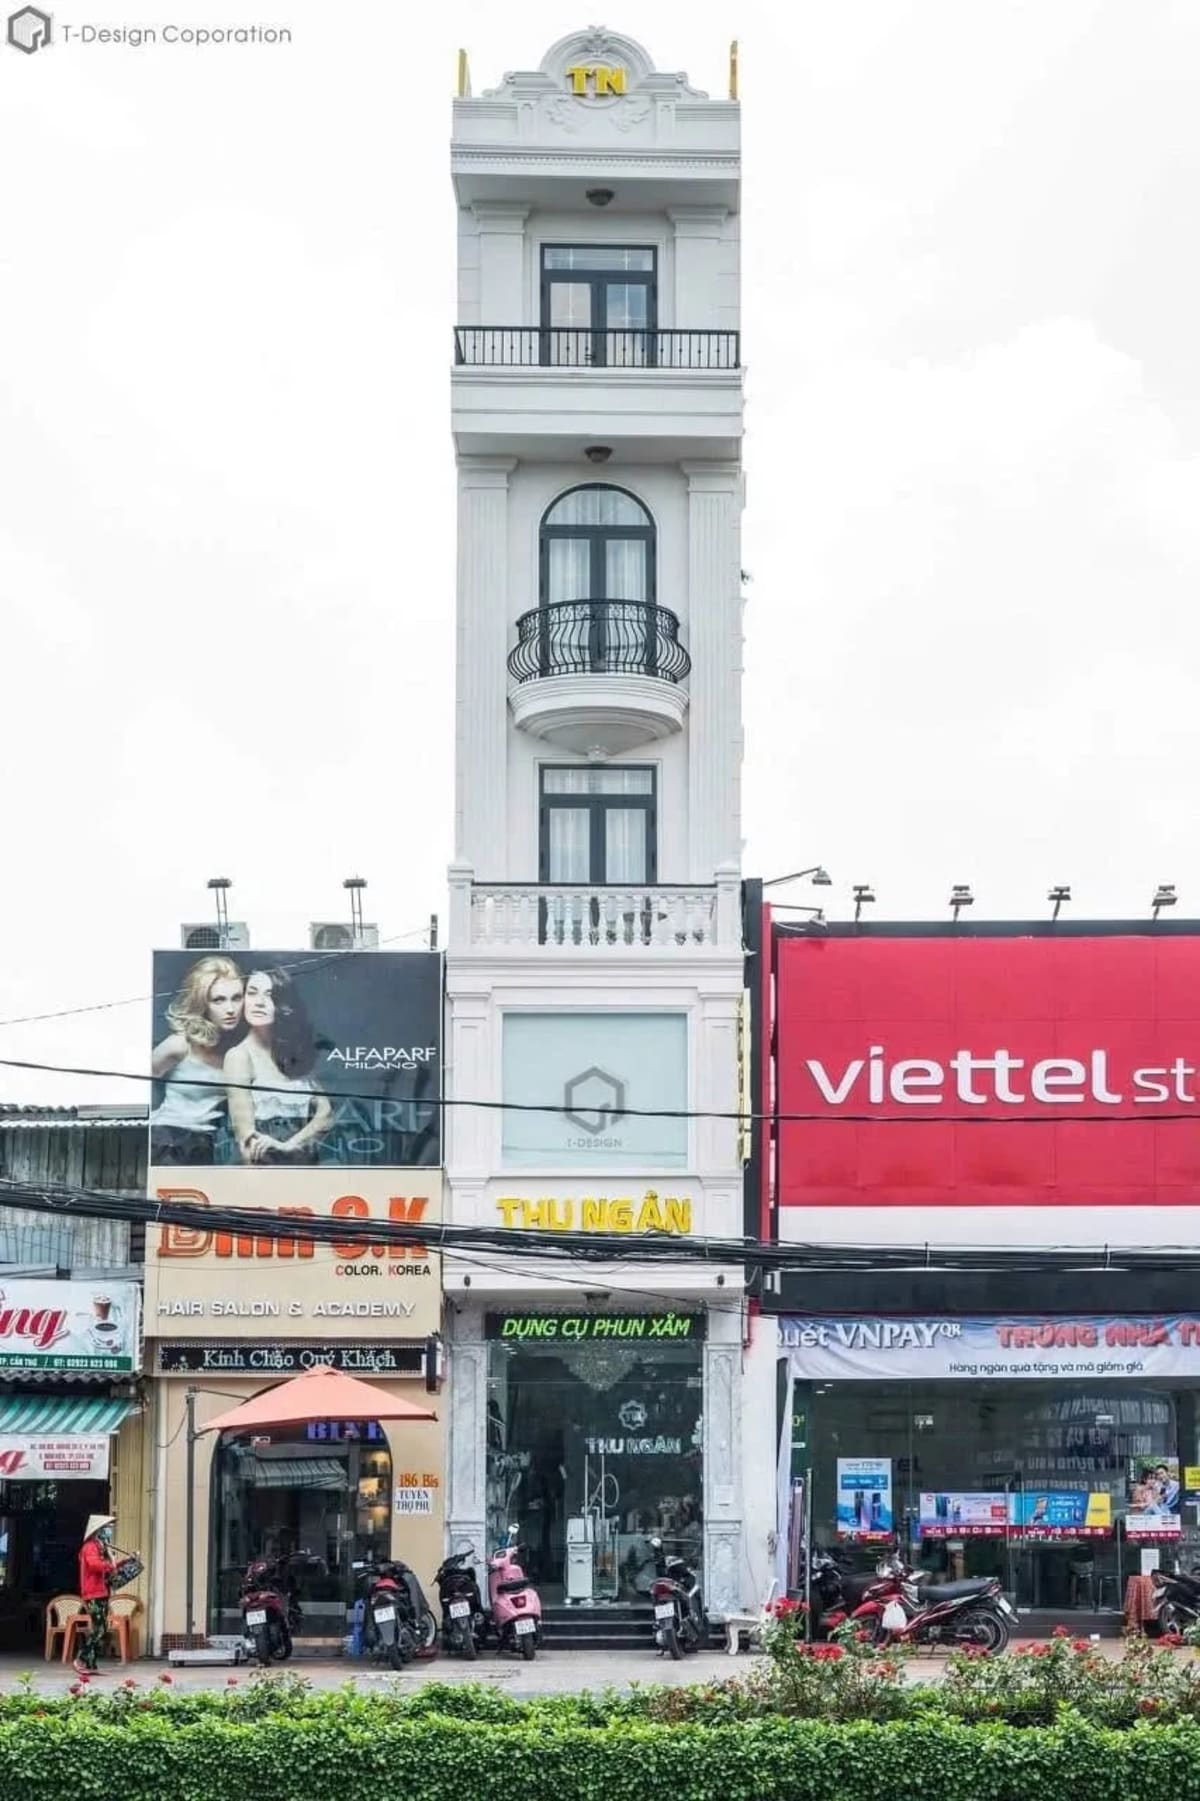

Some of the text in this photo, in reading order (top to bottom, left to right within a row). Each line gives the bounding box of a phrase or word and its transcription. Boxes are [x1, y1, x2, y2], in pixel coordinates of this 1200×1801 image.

[566, 65, 628, 96] TN
[327, 1047, 436, 1061] ALFAPARF
[345, 1062, 417, 1070] MILANO
[806, 1046, 1122, 1104] viettel
[496, 1190, 692, 1234] THU NGÂN
[335, 1264, 431, 1277] COLOR. KOREA
[157, 1301, 416, 1318] HAIR SALON & ACADEMY
[502, 1319, 557, 1341] DỤNG
[561, 1319, 588, 1341] CỤ
[592, 1319, 646, 1337] PHUN
[1176, 1321, 1200, 1346] T
[585, 1437, 624, 1454] THU
[399, 1472, 418, 1488] 186
